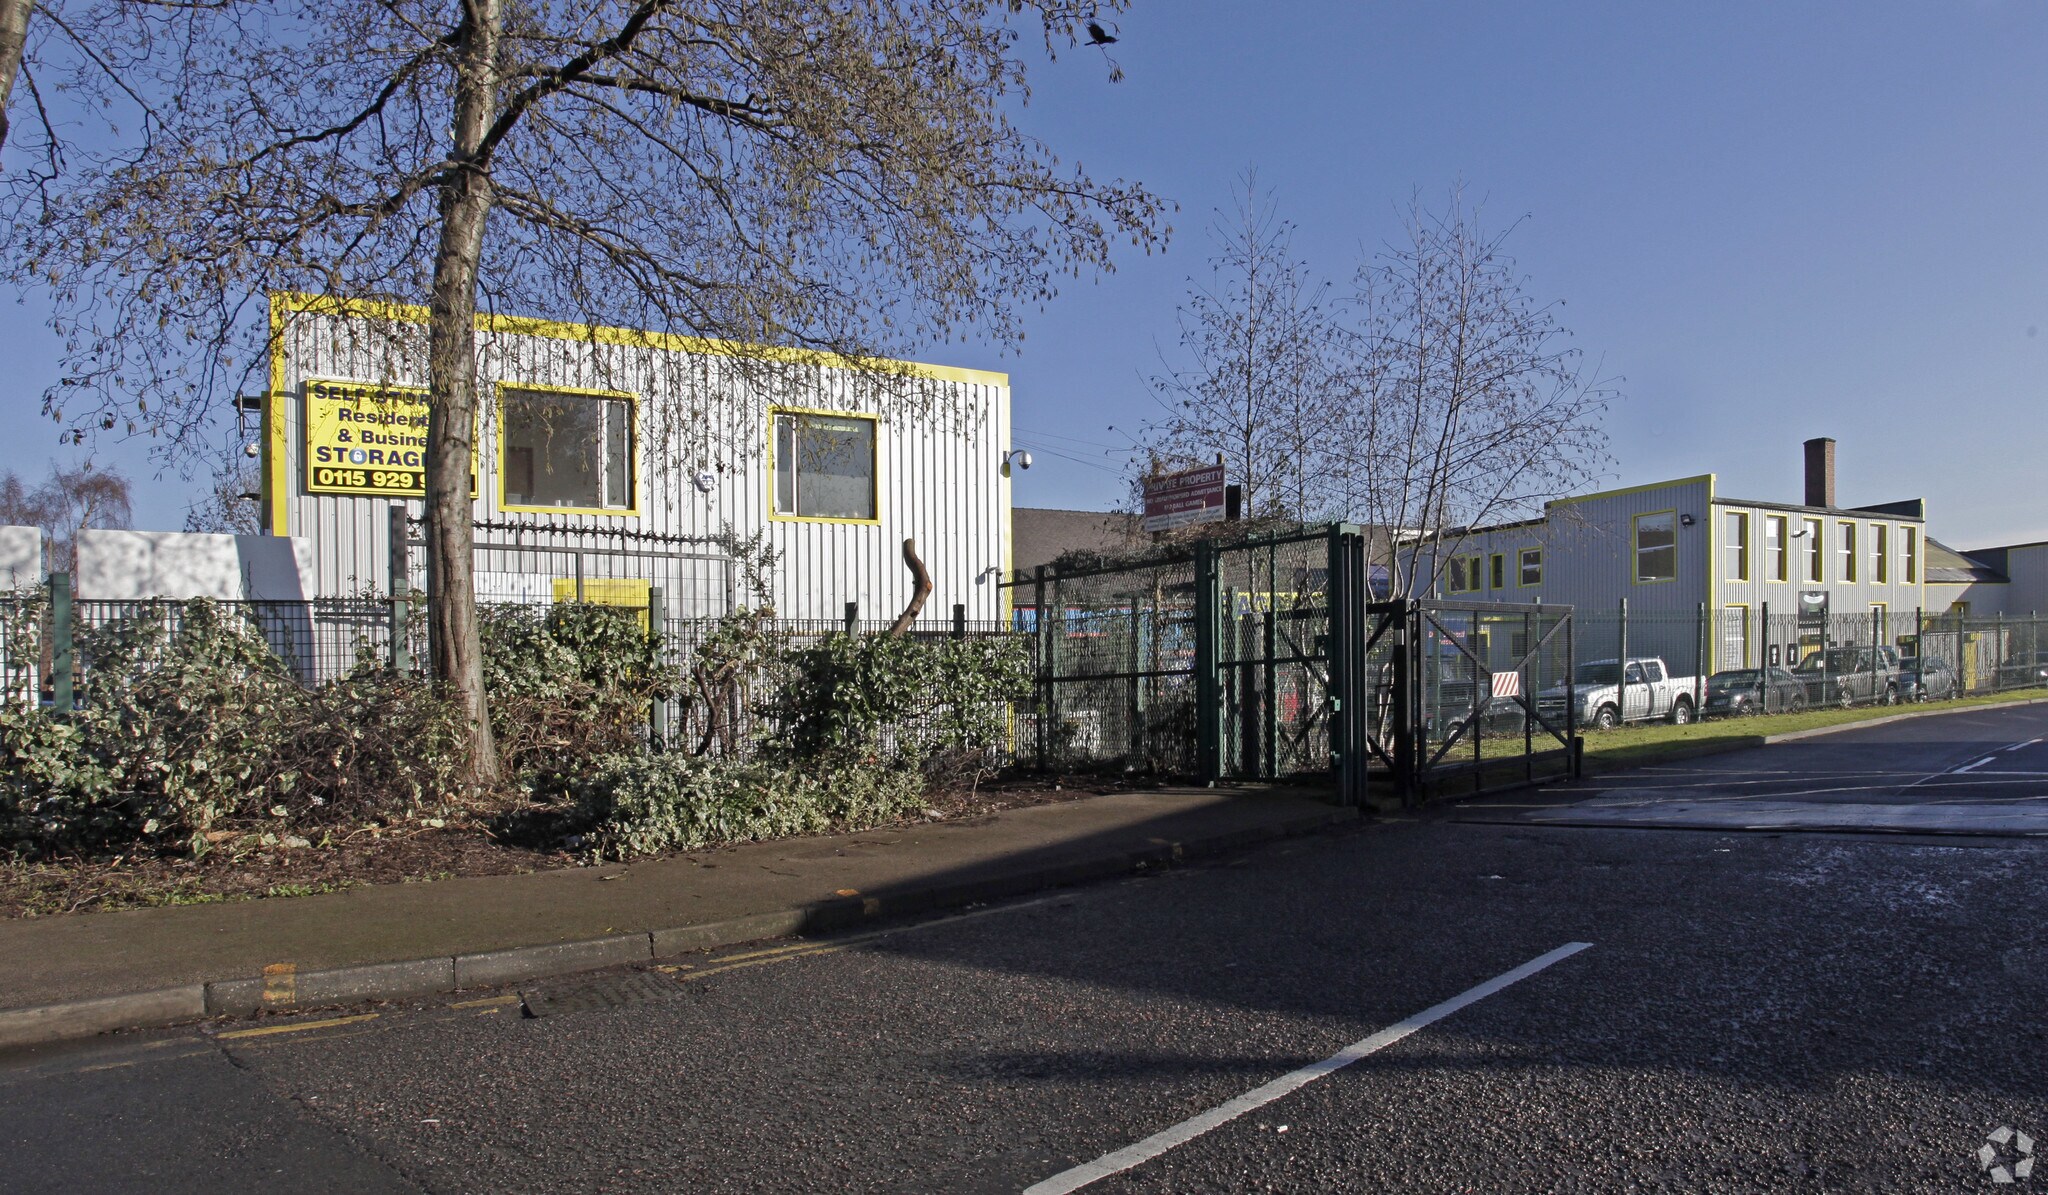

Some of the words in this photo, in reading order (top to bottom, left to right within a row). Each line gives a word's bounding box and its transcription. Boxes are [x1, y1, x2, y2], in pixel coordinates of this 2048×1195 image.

[314, 384, 366, 401] SELF
[337, 428, 353, 443] &
[361, 430, 428, 447] Busine
[319, 469, 366, 486] 0115
[372, 471, 414, 489] 929
[1180, 470, 1222, 486] PROPERTY
[1185, 499, 1202, 507] GAMES
